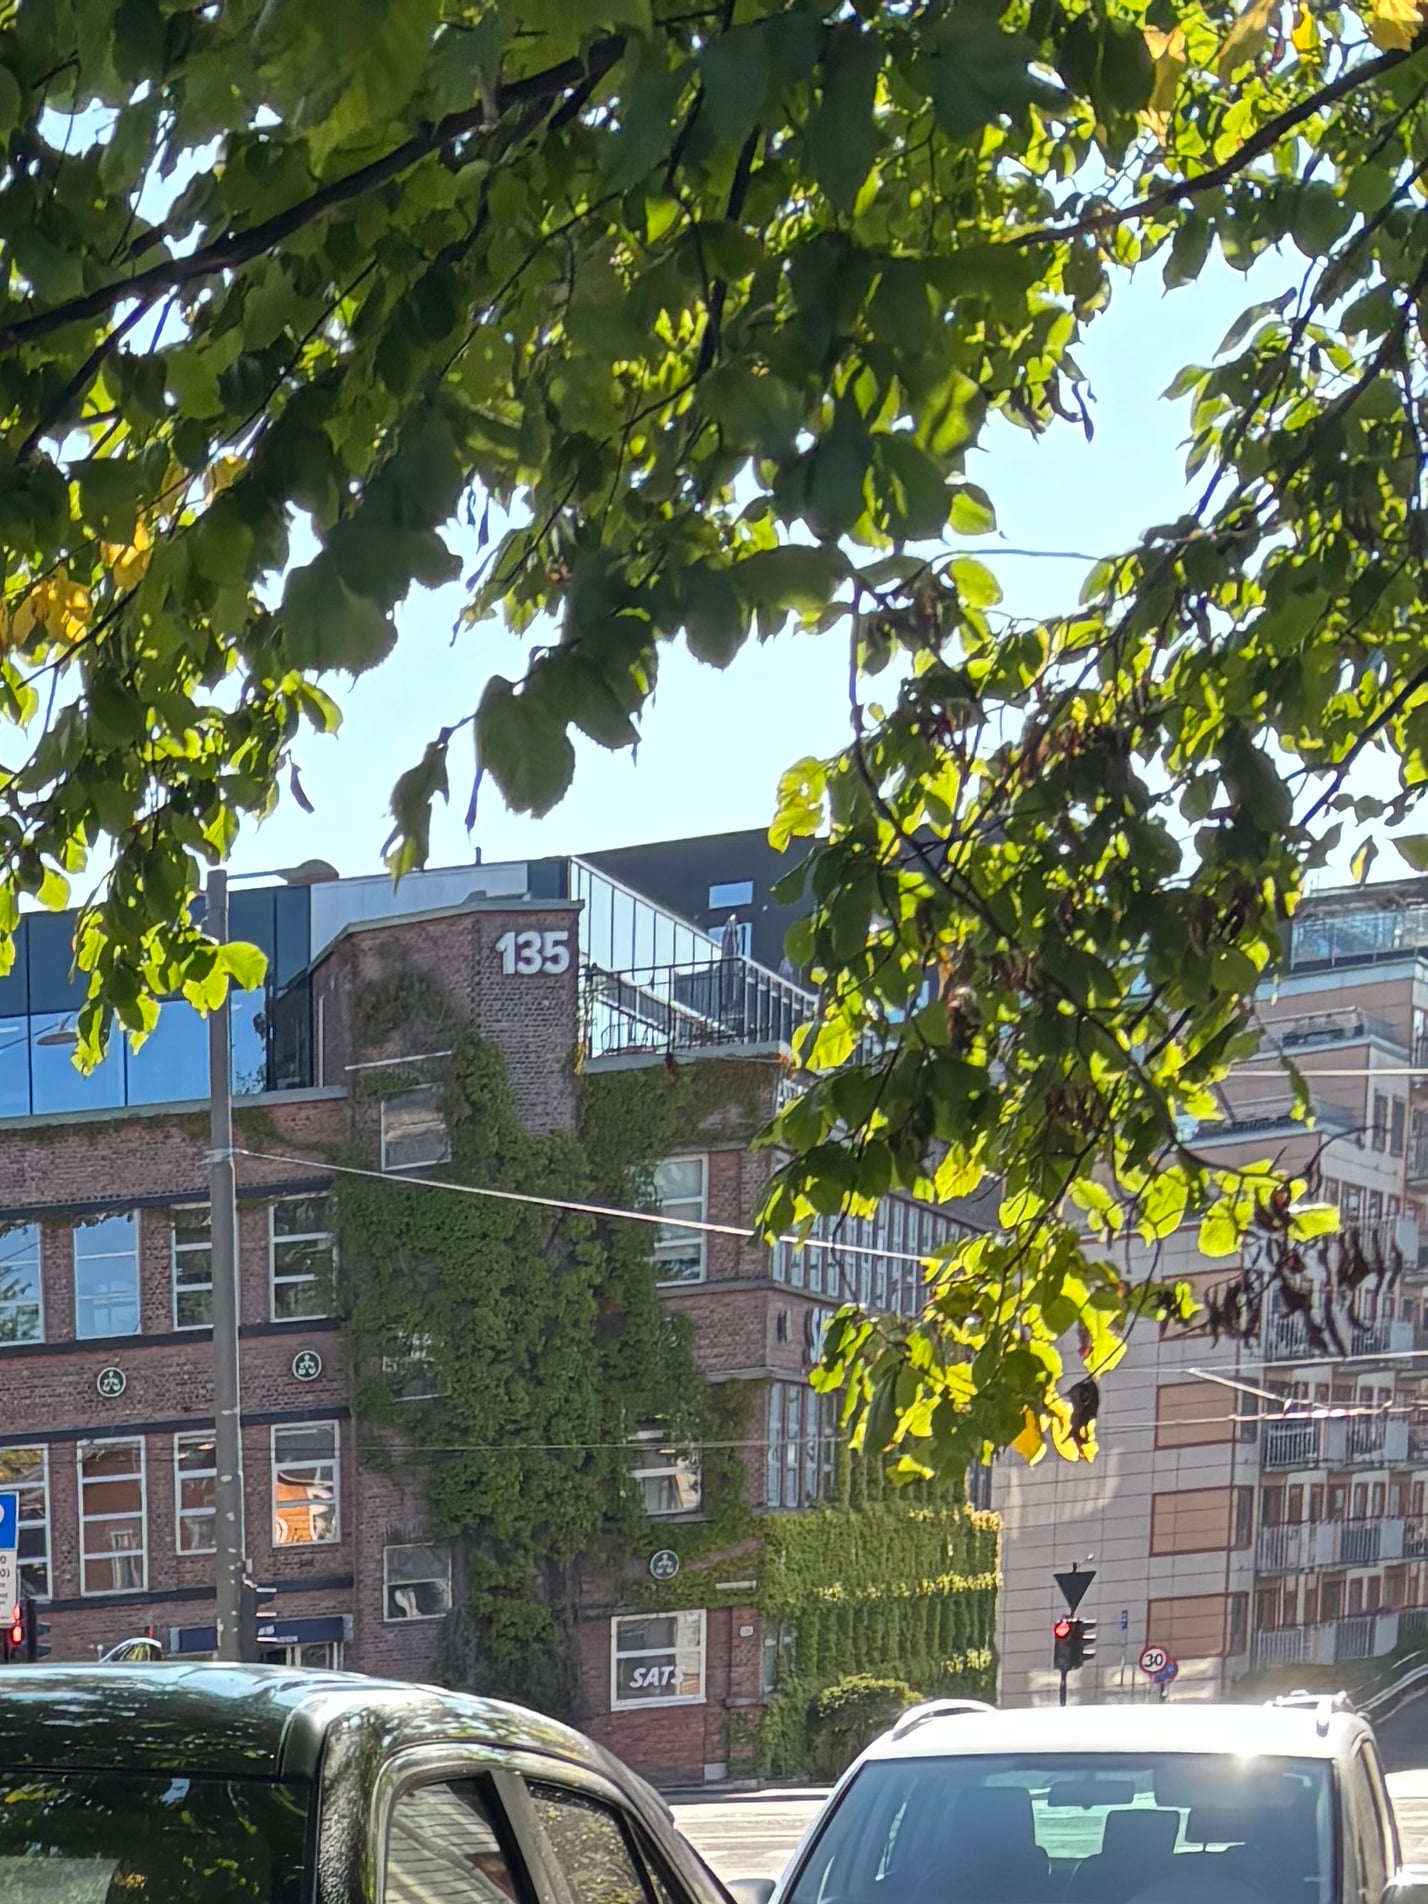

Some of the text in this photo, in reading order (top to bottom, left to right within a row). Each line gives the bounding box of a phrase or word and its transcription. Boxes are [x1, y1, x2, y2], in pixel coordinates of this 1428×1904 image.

[495, 931, 569, 975] 135
[1144, 1653, 1164, 1668] 30
[629, 1665, 686, 1688] SATS
